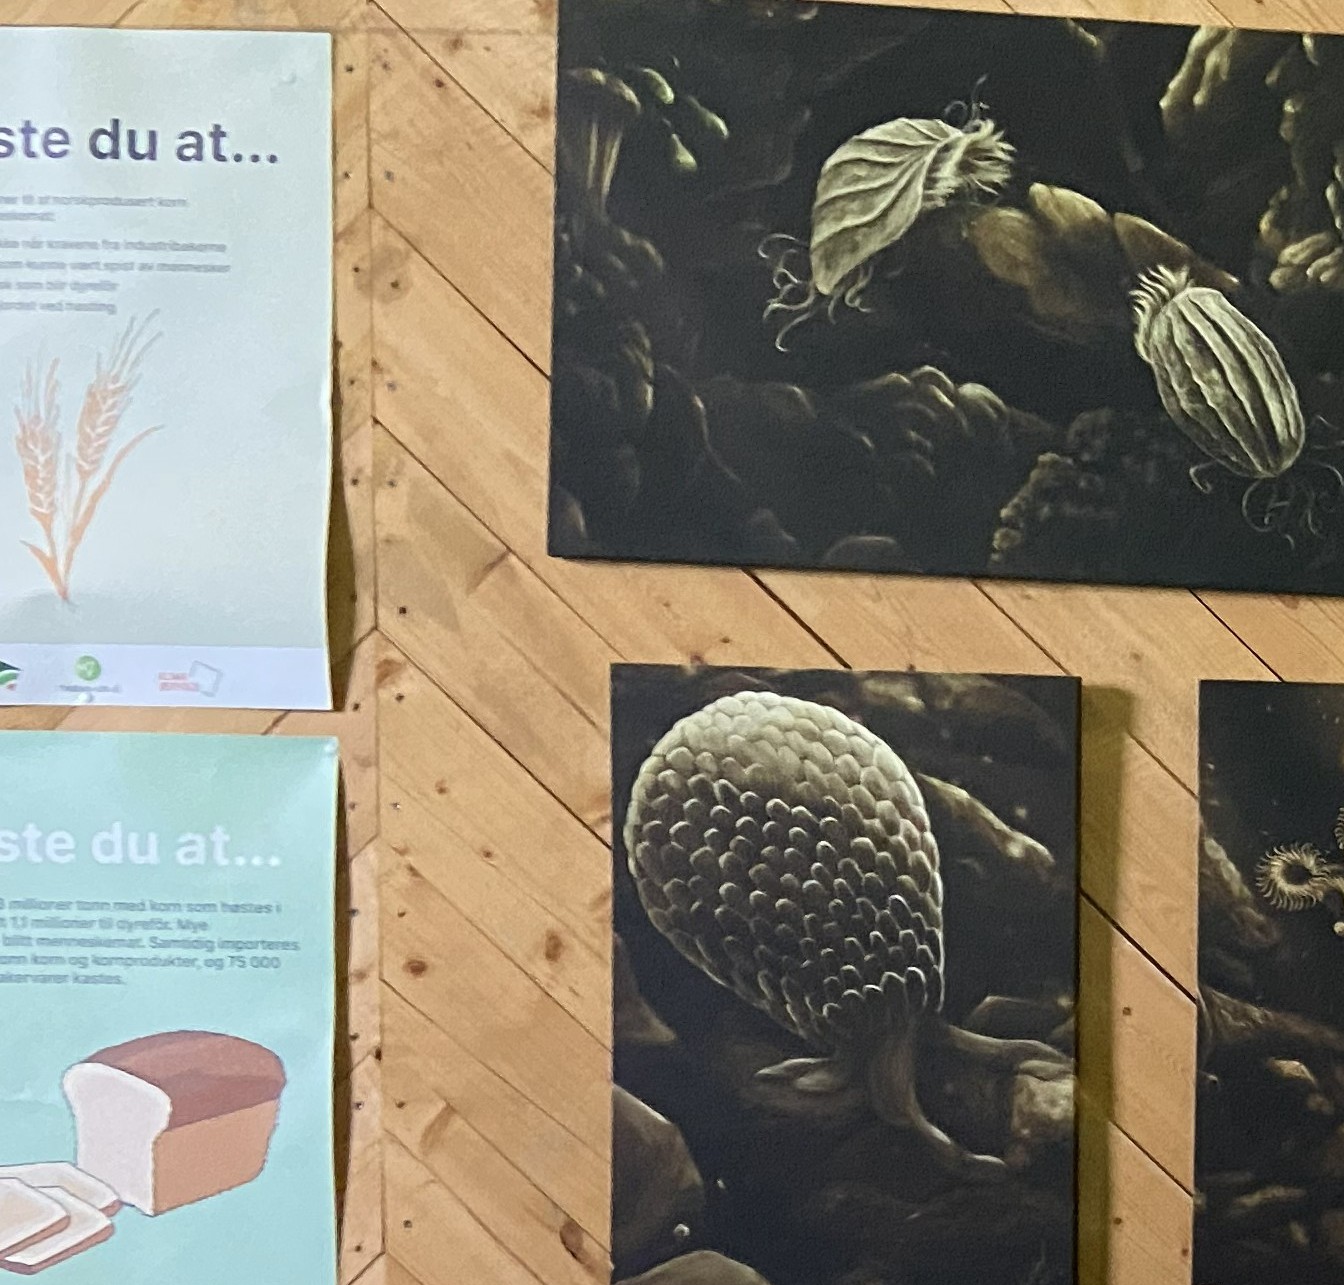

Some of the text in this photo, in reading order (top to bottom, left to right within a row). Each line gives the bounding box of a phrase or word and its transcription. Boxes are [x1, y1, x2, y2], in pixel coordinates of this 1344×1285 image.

[89, 118, 158, 160] du
[176, 123, 279, 164] at...
[0, 821, 282, 867] ste du at...
